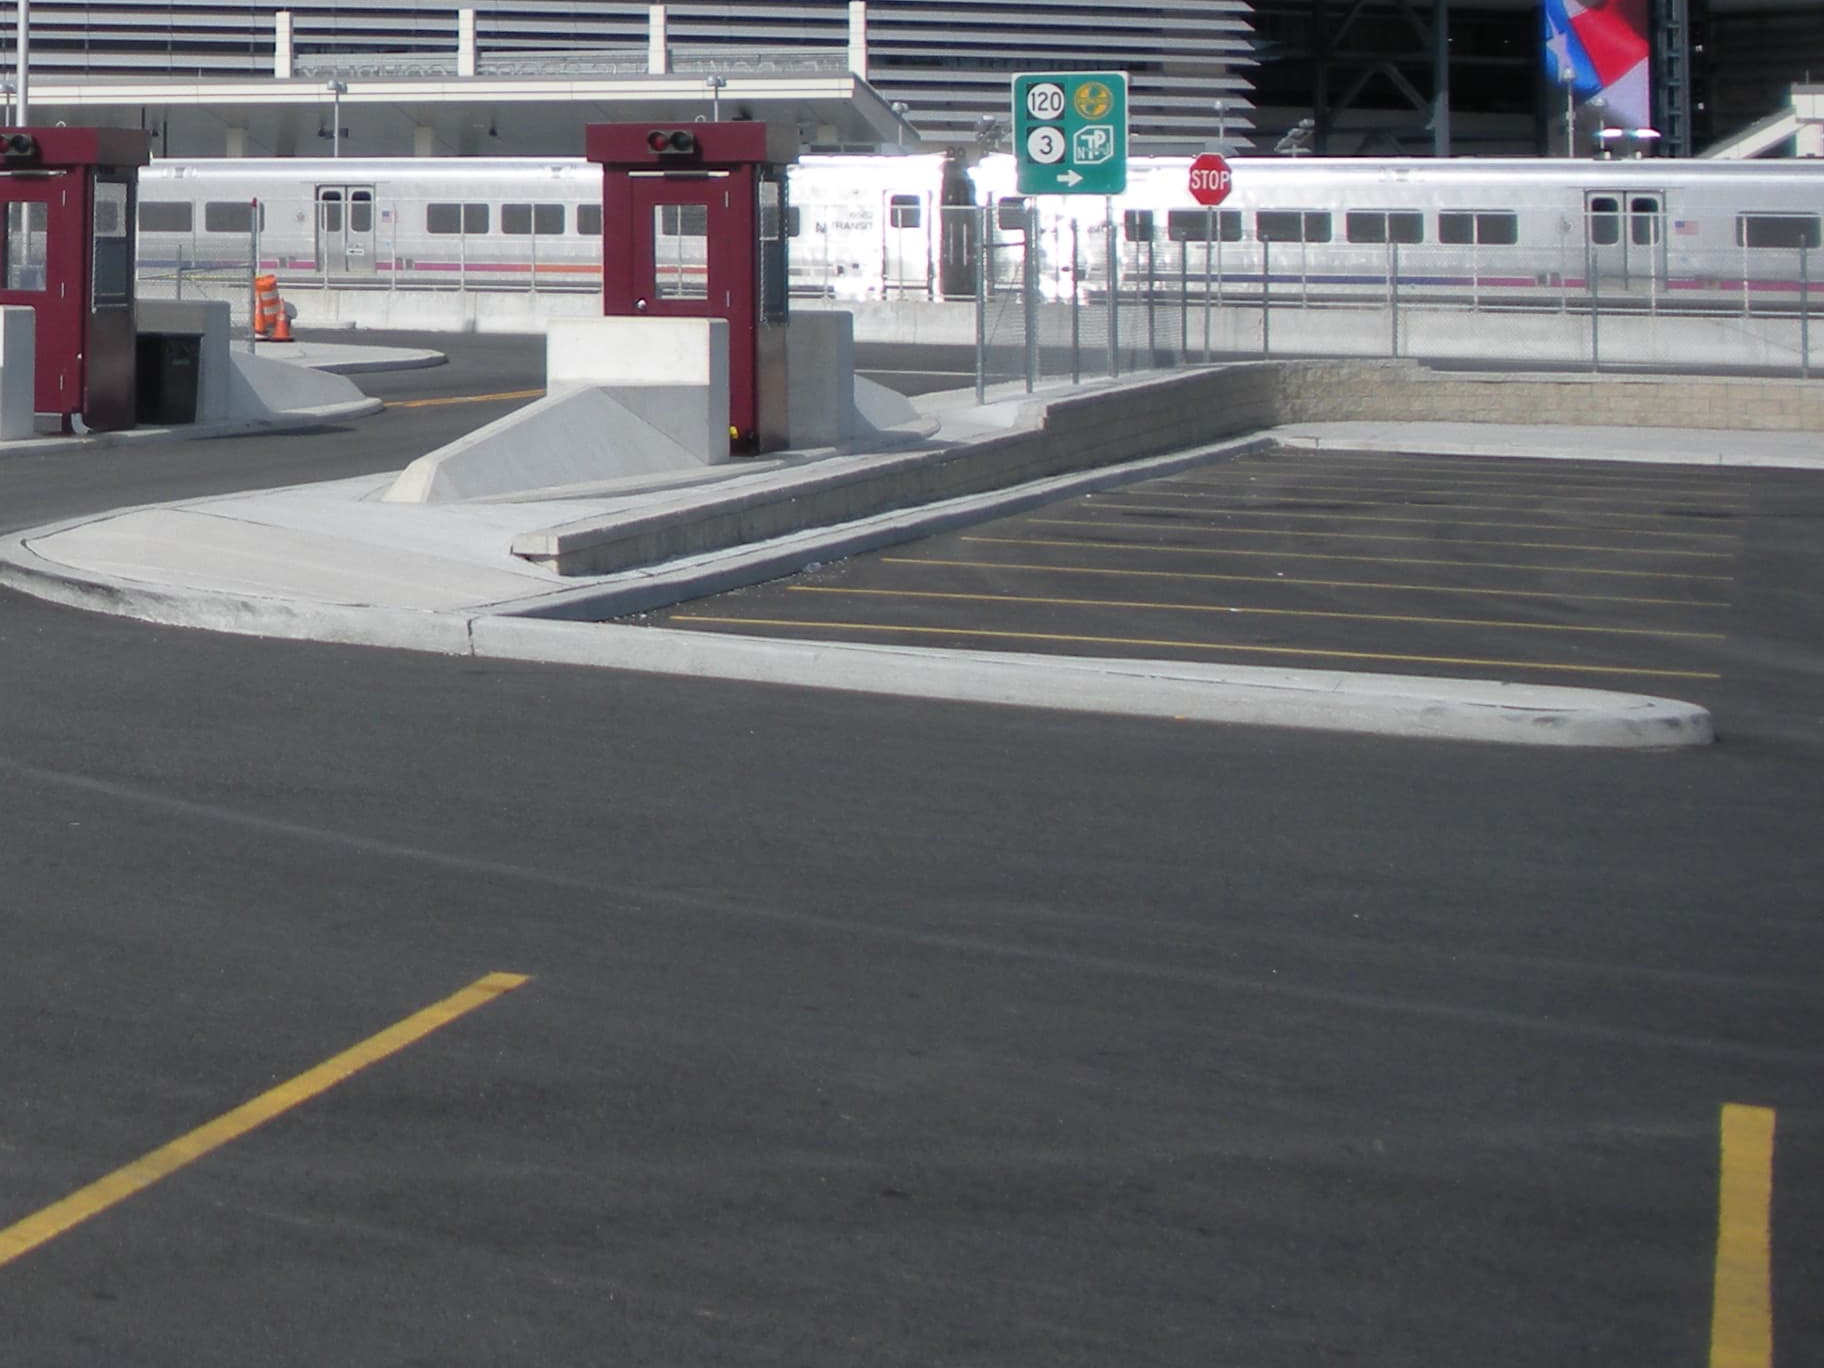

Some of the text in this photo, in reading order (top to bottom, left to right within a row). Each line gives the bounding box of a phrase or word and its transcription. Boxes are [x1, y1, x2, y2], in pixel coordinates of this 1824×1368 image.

[1031, 91, 1062, 112] 120
[1040, 135, 1053, 155] 3
[1191, 169, 1230, 190] STOP
